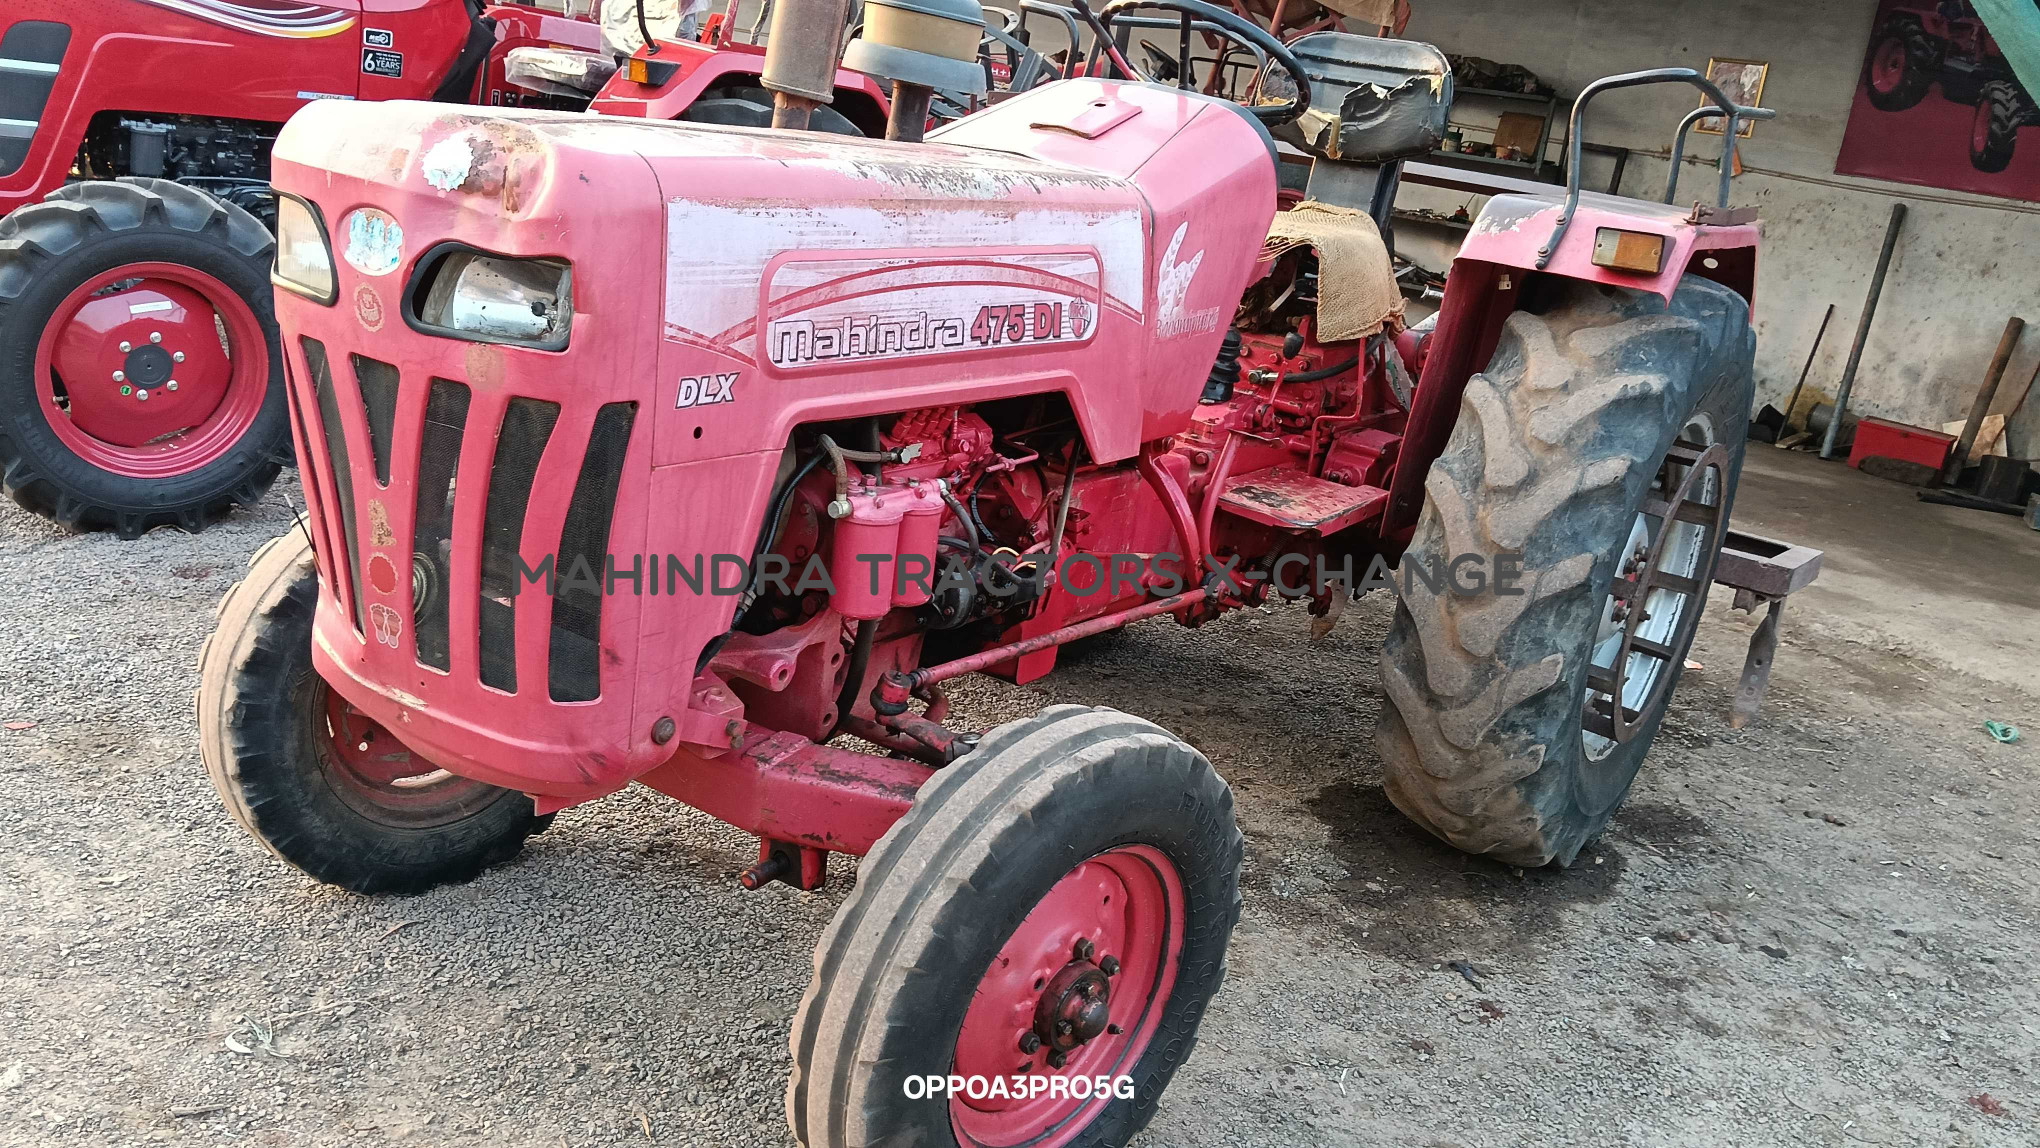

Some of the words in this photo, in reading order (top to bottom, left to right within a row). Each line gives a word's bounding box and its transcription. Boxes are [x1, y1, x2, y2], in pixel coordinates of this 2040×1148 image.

[365, 53, 376, 72] 6
[376, 60, 401, 70] YEARS
[773, 312, 965, 364] Mahindra
[970, 305, 1025, 346] 475
[1033, 302, 1062, 340] DI
[674, 371, 742, 409] DLX
